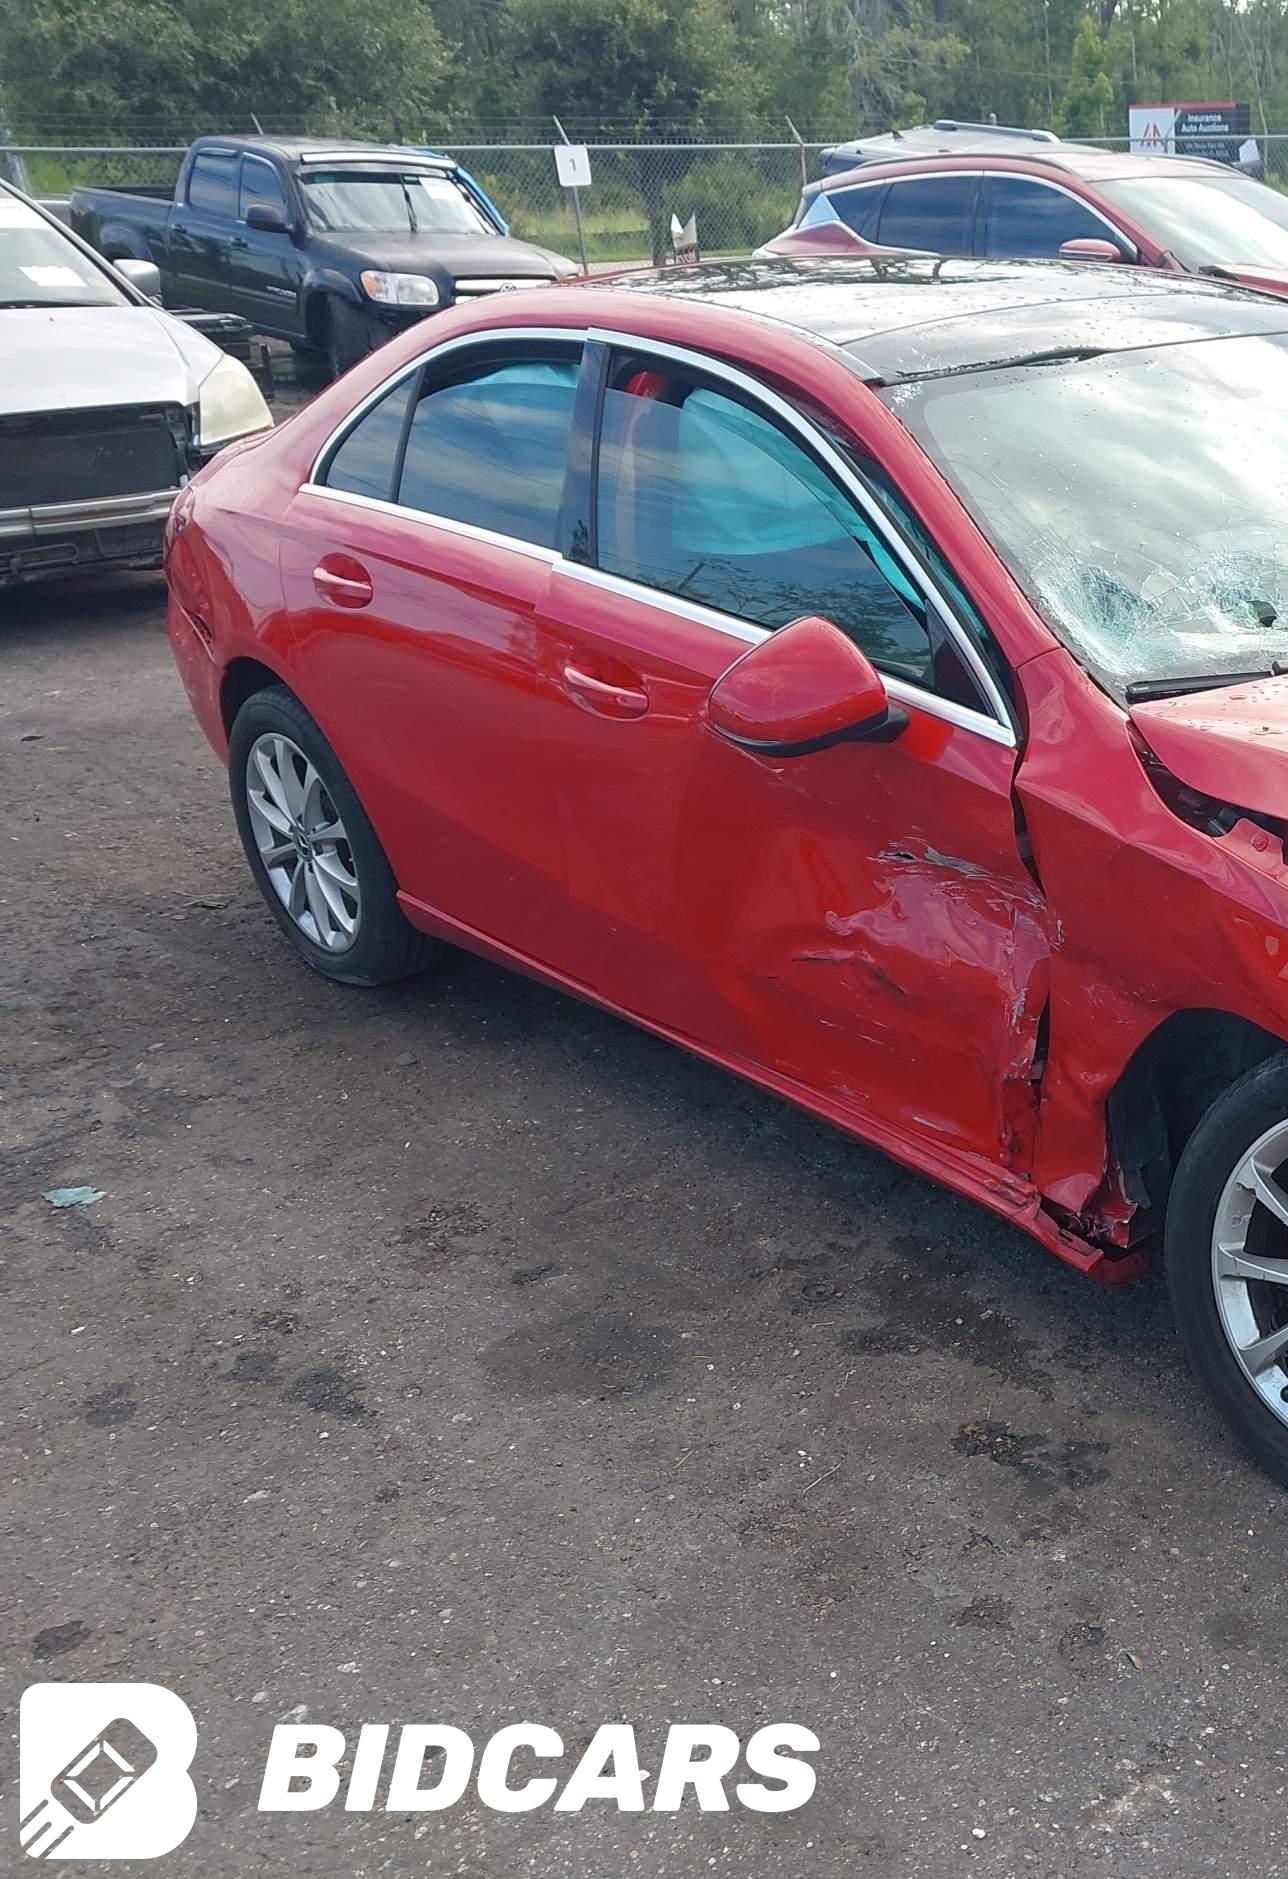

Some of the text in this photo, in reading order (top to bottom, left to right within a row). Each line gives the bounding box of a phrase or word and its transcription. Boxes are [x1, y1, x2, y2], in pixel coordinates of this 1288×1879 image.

[1187, 113, 1222, 122] Insurance
[1181, 122, 1229, 133] Auto Auctions
[569, 158, 577, 172] 1
